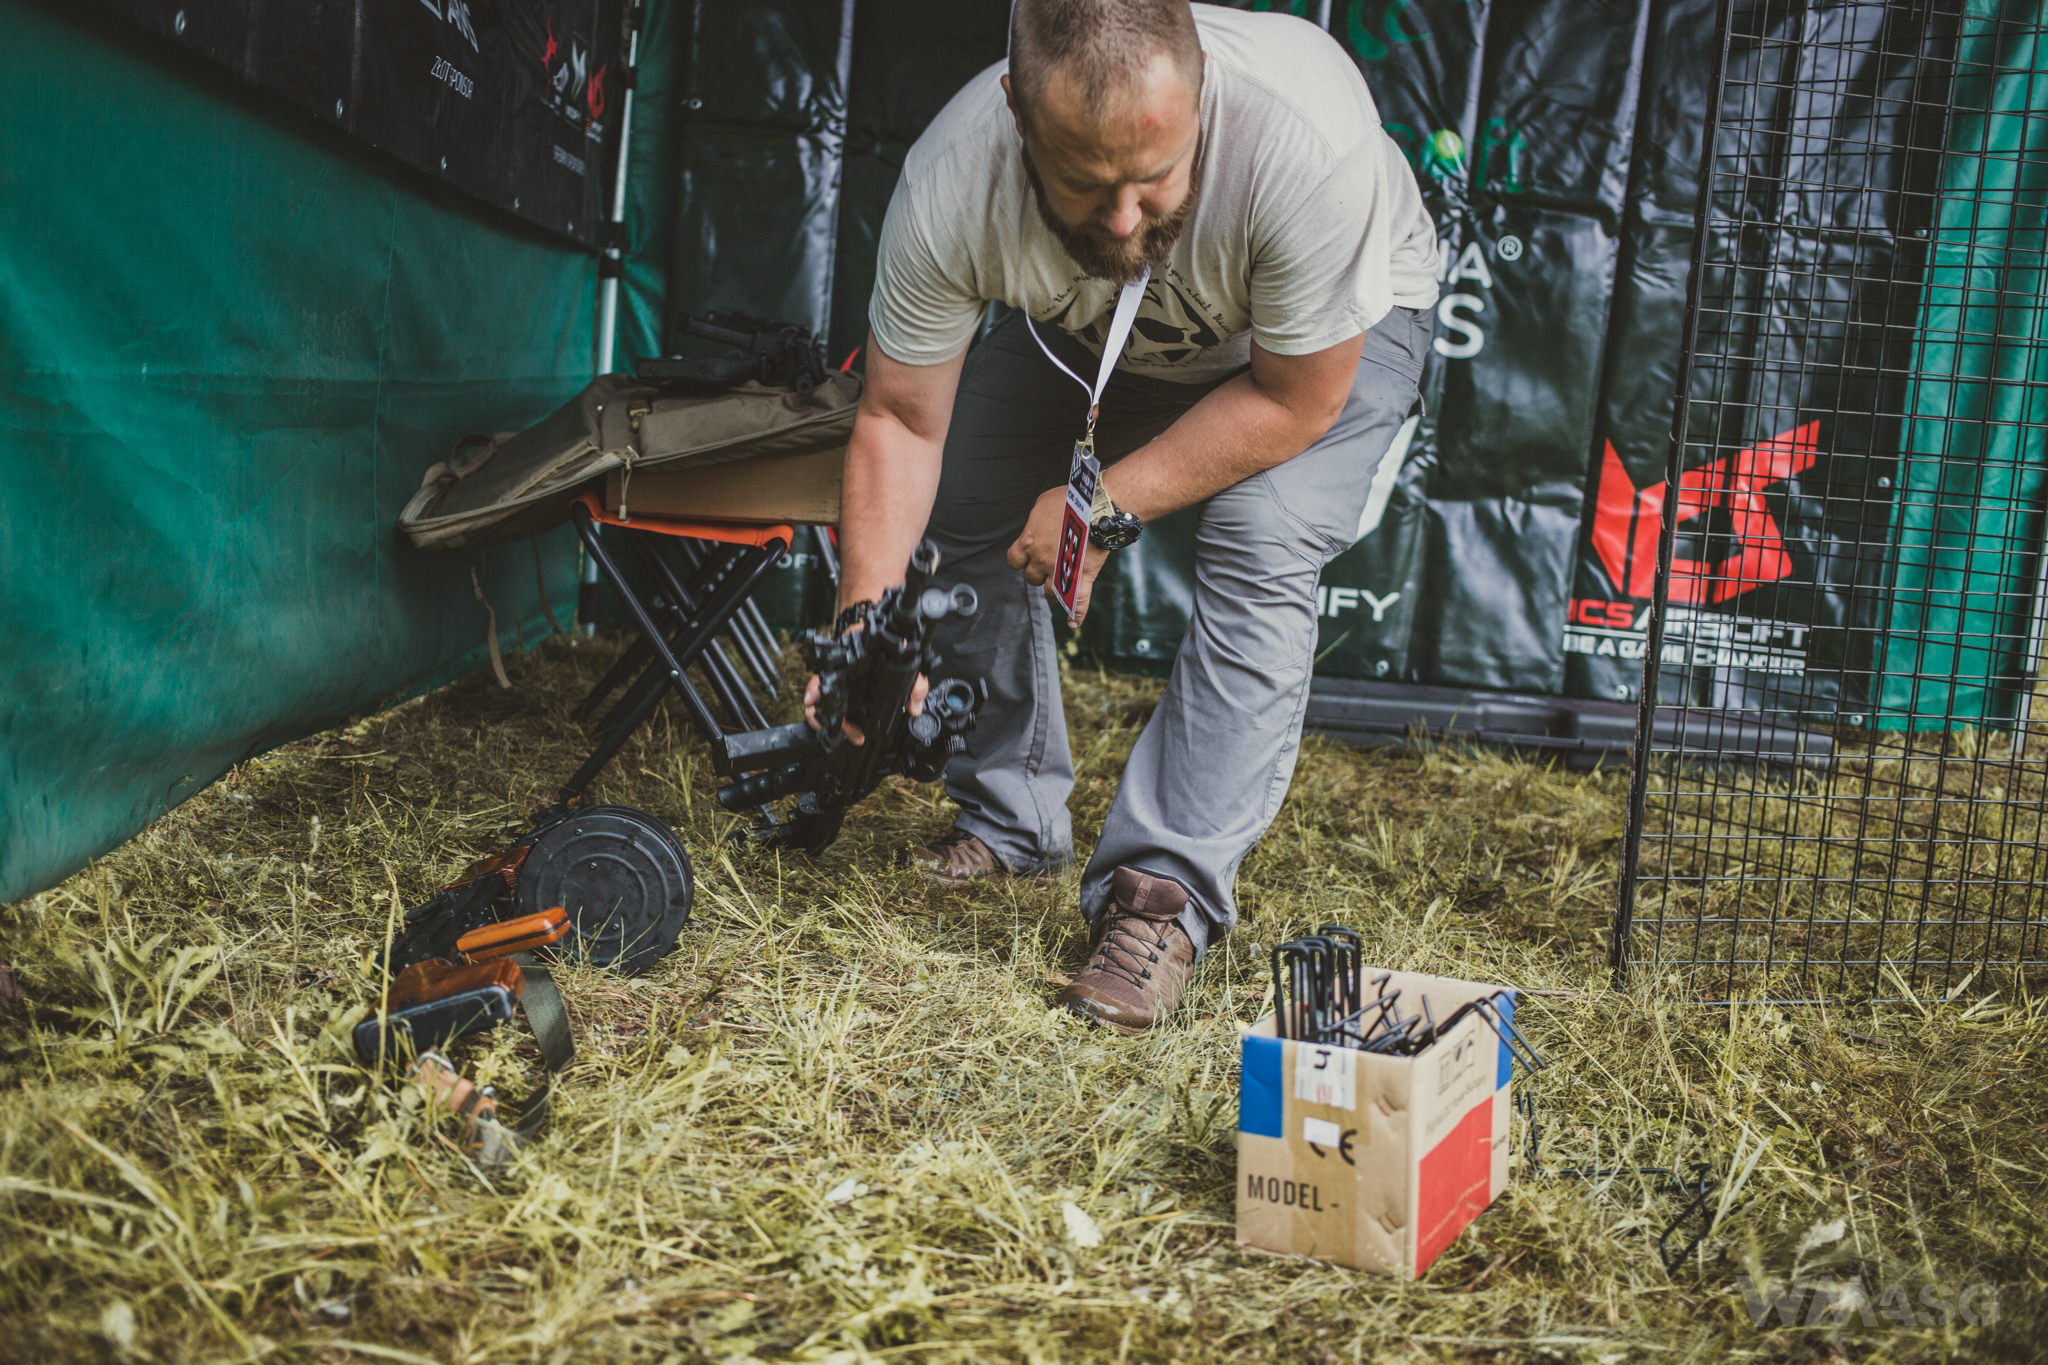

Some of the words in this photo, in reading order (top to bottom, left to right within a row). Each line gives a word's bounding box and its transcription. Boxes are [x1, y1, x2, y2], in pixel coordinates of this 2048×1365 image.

[1563, 633, 1596, 653] BE
[1597, 638, 1617, 656] A
[1247, 1174, 1324, 1213] MODEL
